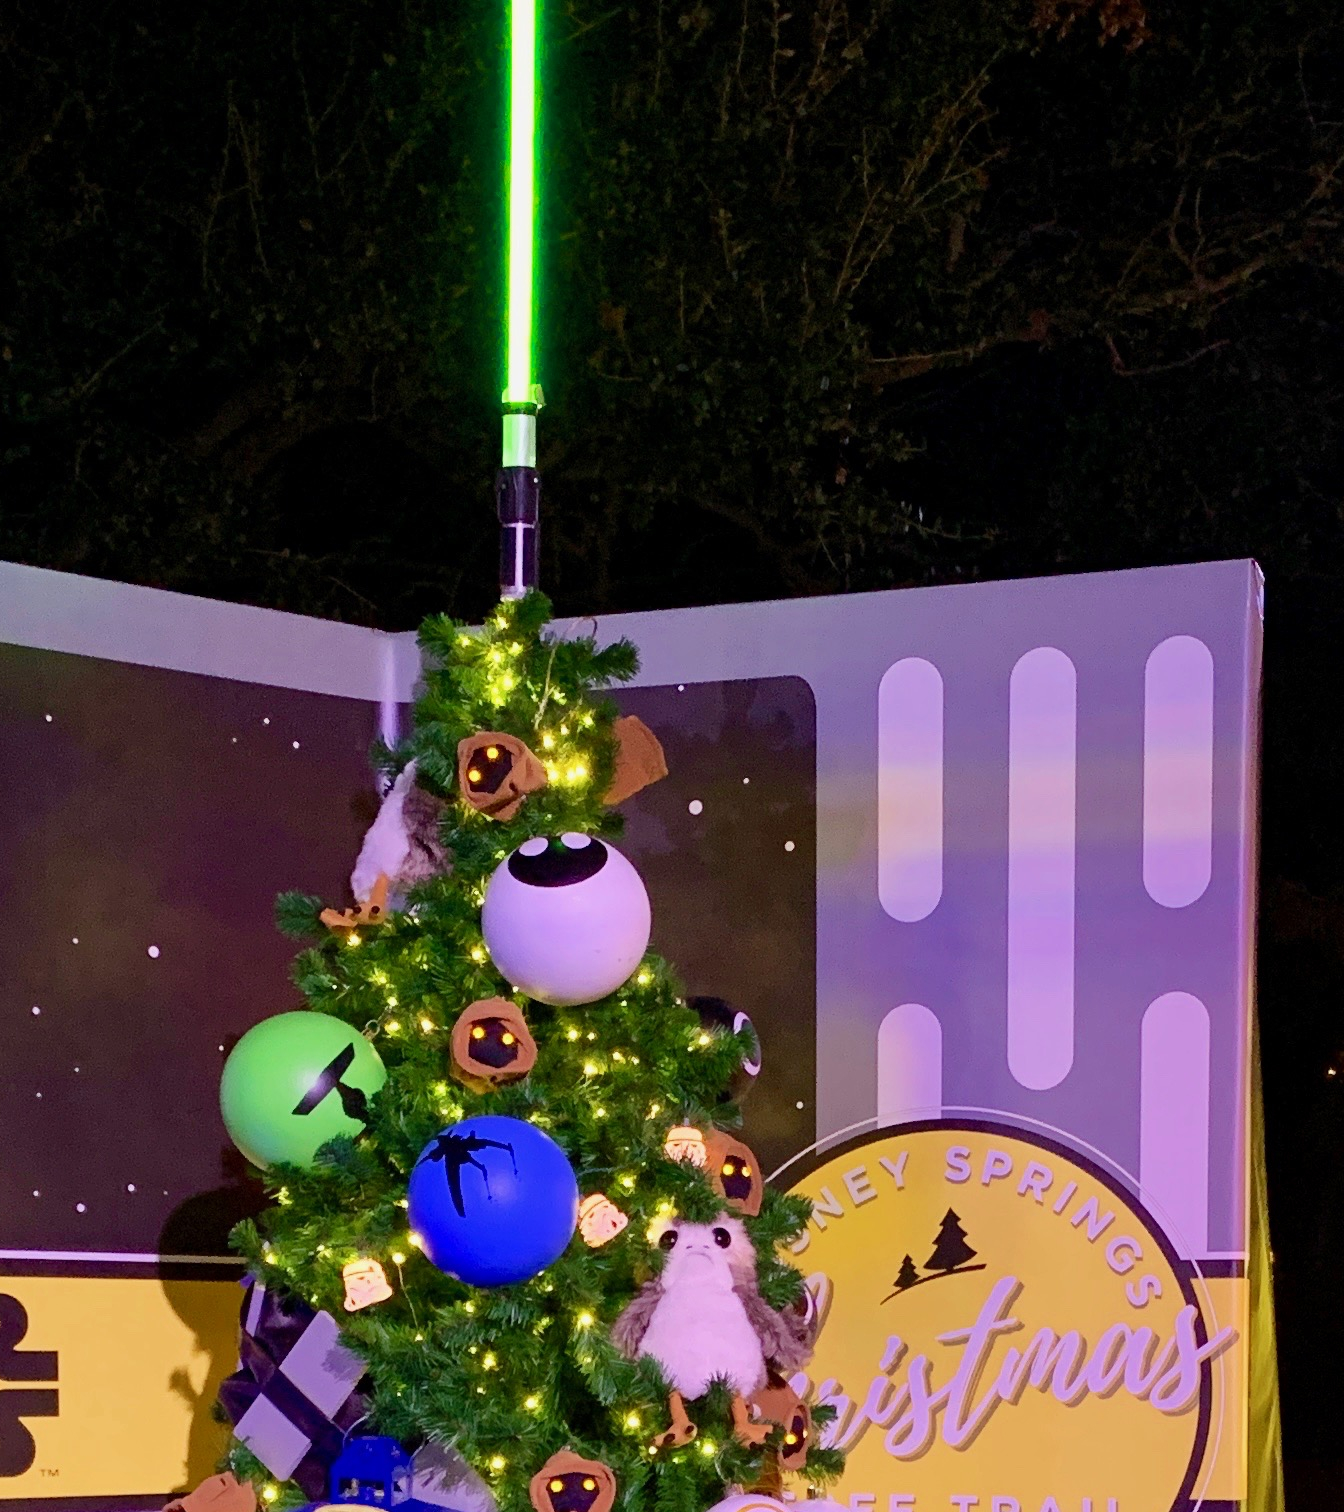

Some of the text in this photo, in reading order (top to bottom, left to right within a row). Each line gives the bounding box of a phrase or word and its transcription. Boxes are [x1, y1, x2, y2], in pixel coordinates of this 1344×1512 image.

[786, 1145, 1163, 1310] NEY SPRINGS
[786, 1271, 1238, 1459] ristmas
